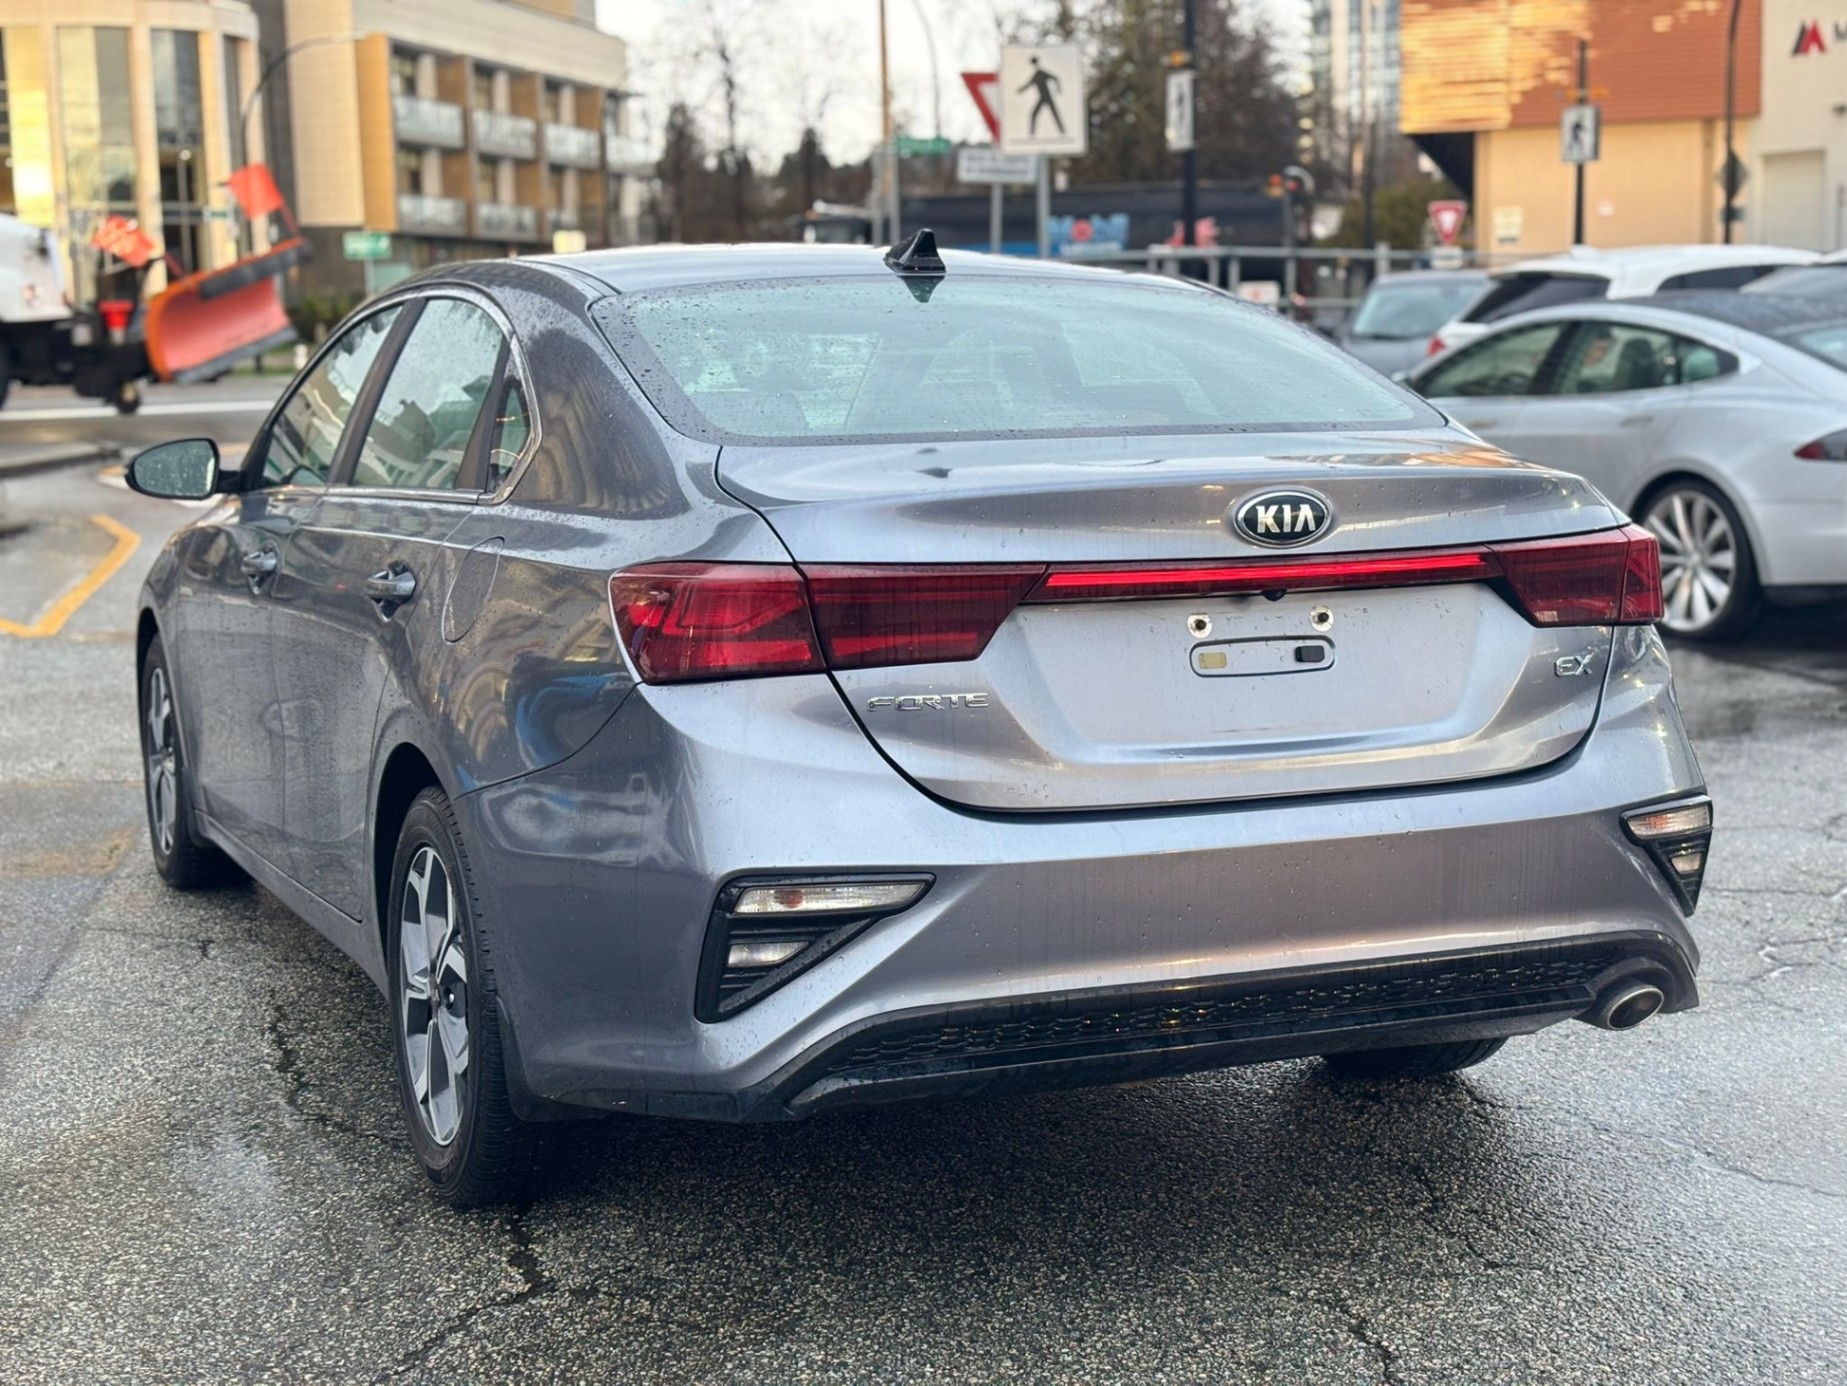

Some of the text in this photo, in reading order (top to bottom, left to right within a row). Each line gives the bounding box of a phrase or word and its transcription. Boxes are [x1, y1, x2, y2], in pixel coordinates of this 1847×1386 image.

[1255, 504, 1316, 533] KIA
[1554, 652, 1594, 677] EX
[867, 692, 989, 712] FORTE
